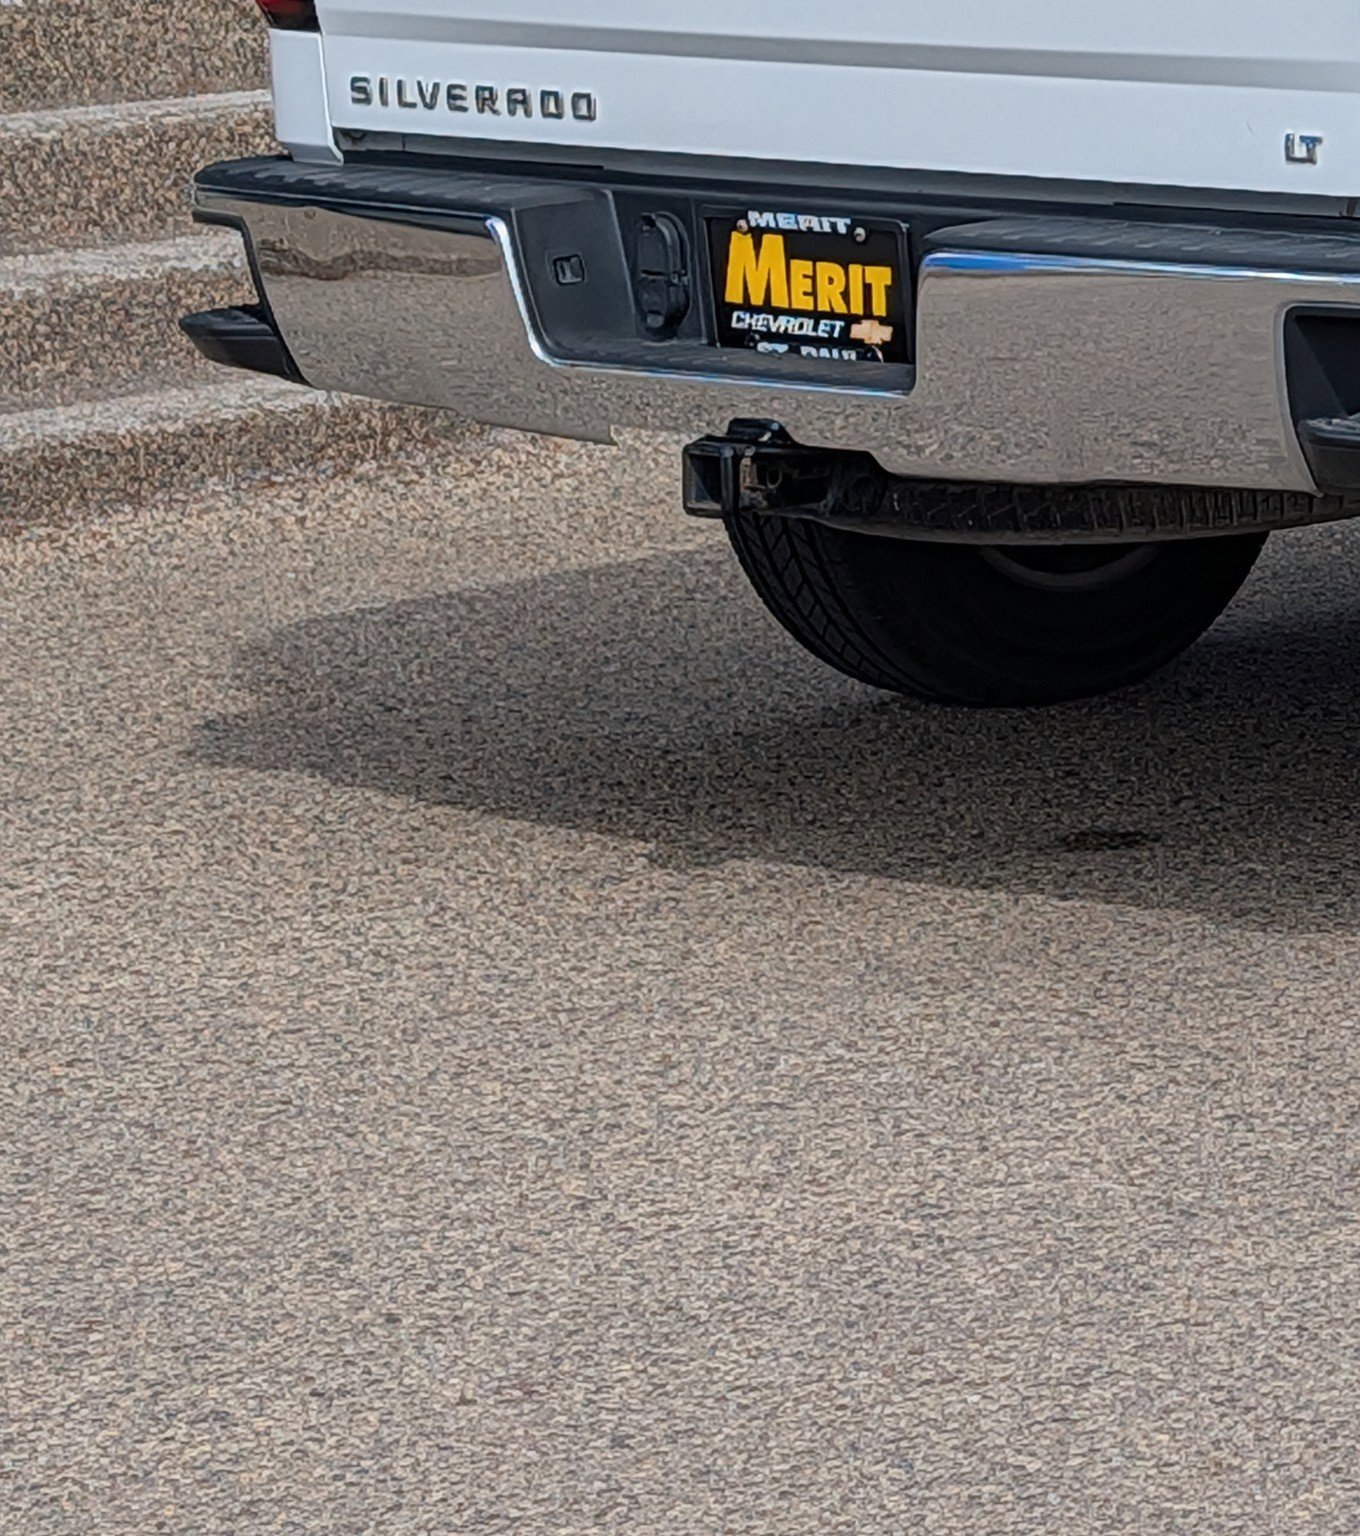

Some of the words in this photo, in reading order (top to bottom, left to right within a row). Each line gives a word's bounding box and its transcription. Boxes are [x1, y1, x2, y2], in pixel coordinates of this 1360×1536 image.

[350, 76, 597, 121] SILVERADO
[1284, 133, 1323, 165] LT
[747, 210, 851, 235] MERIT
[725, 231, 892, 317] MERIT
[731, 310, 845, 338] CHEVROLET
